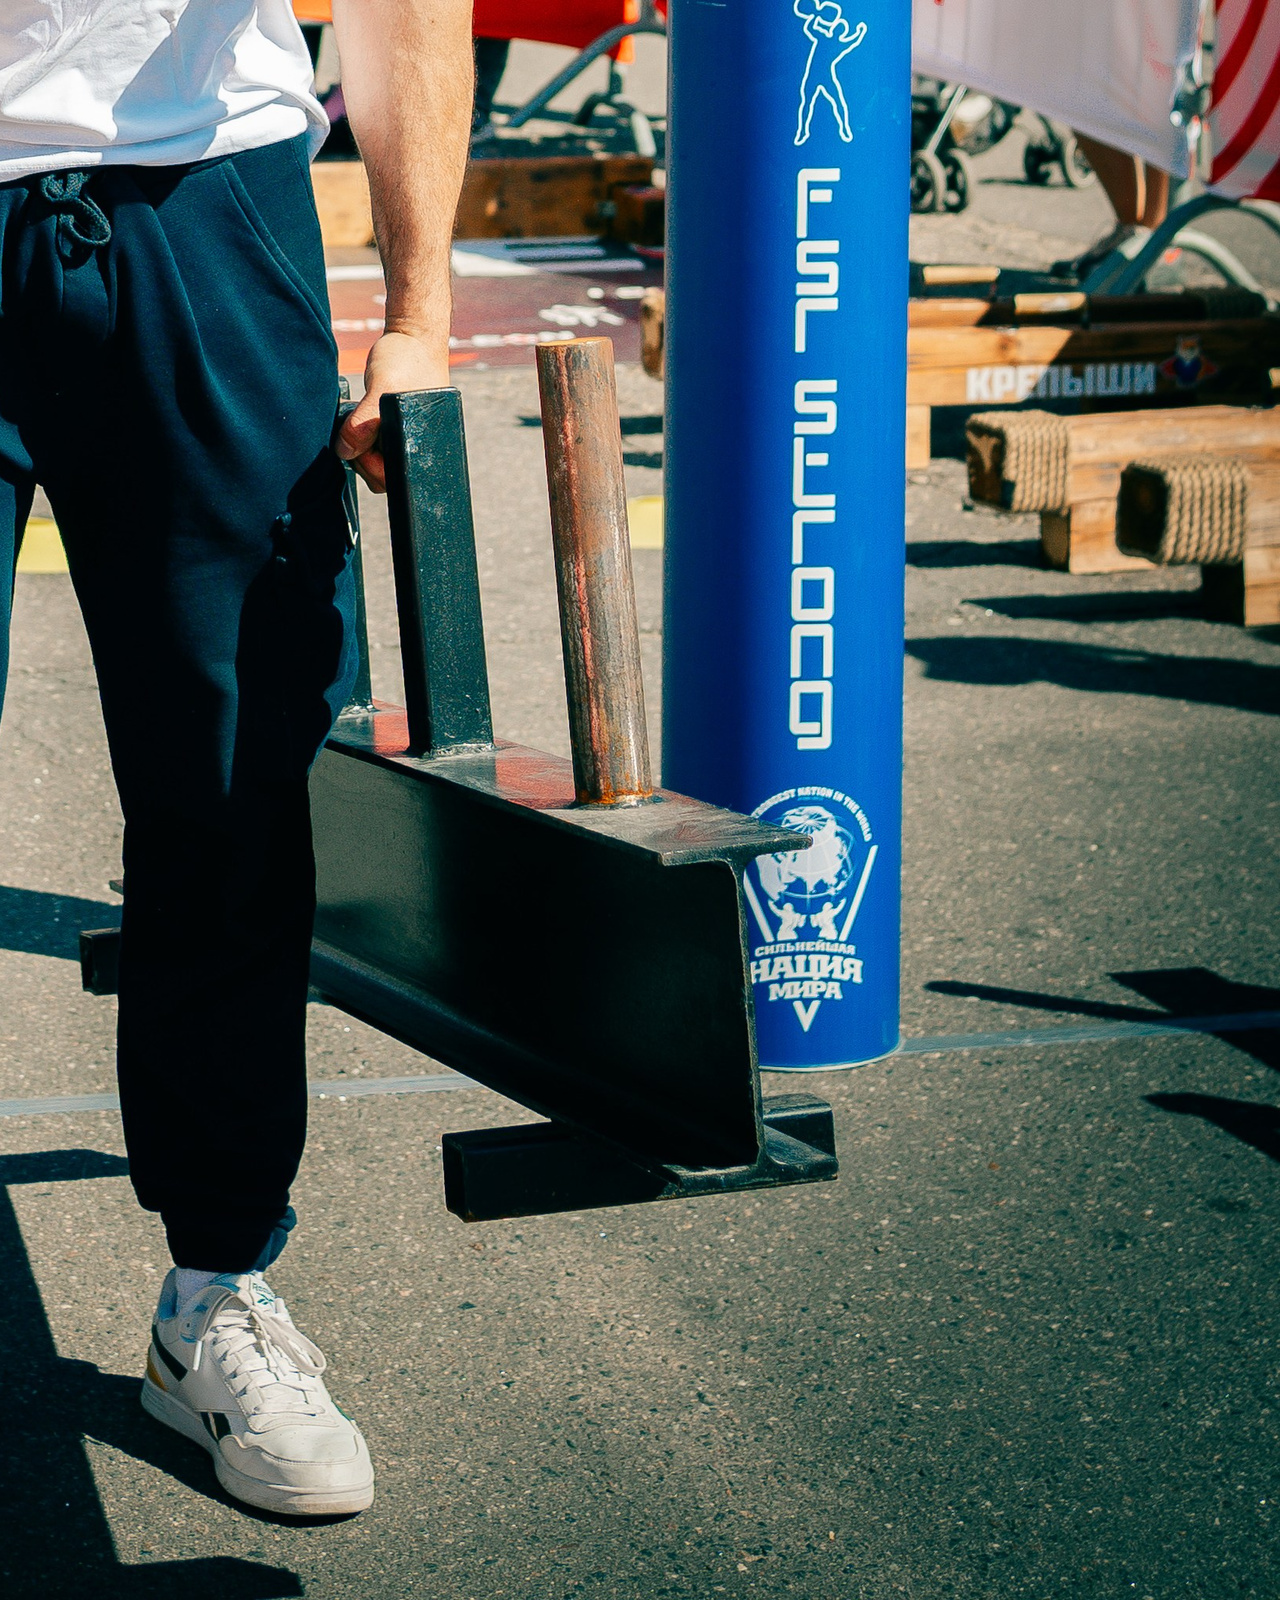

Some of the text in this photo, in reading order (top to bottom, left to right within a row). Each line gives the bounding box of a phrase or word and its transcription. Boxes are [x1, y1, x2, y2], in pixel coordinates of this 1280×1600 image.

[966, 361, 1158, 402] КРЕПЫШИ
[754, 939, 857, 958] СИЛЬНЕЙШАЯ
[750, 953, 864, 985] НАЦИЯ
[768, 980, 844, 1002] МИРА
